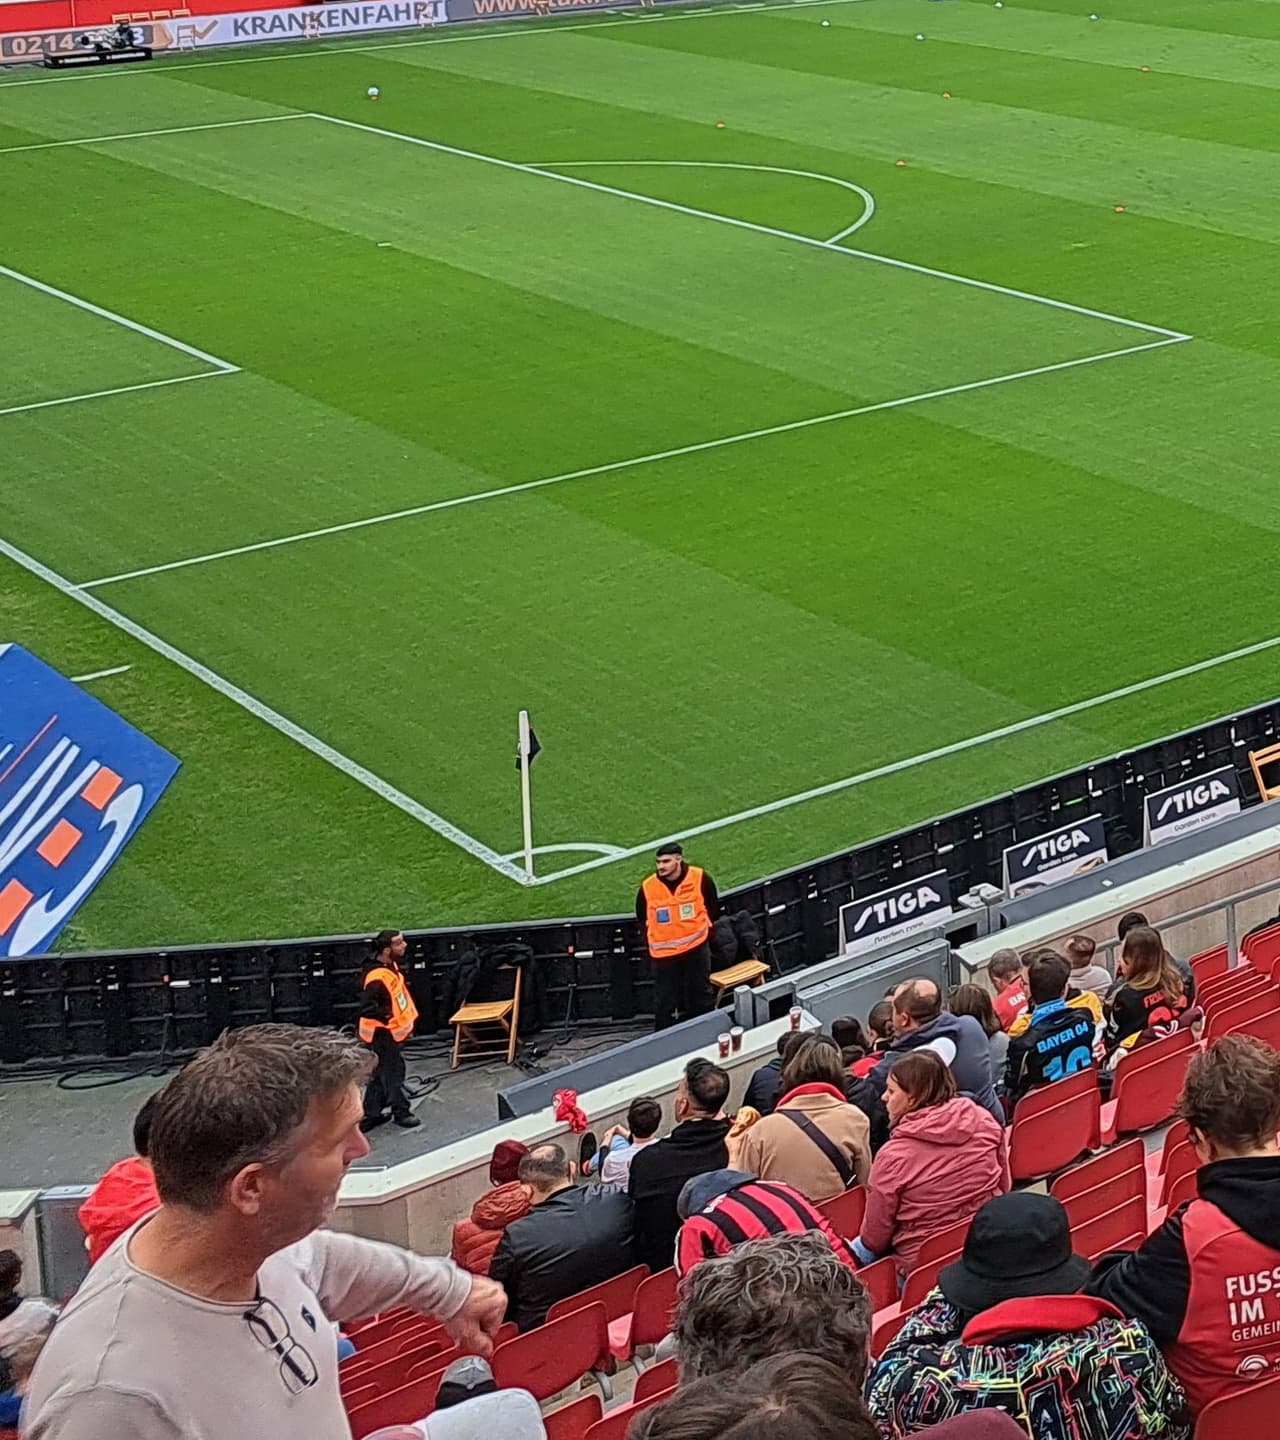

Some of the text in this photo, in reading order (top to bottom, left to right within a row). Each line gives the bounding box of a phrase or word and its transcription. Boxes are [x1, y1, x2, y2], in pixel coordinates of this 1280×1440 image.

[1156, 779, 1231, 822] STIGA
[1021, 828, 1091, 868] STIGA
[853, 885, 942, 934] STIGA
[1036, 1020, 1090, 1054] BAYER 04
[1229, 1298, 1265, 1331] IM
